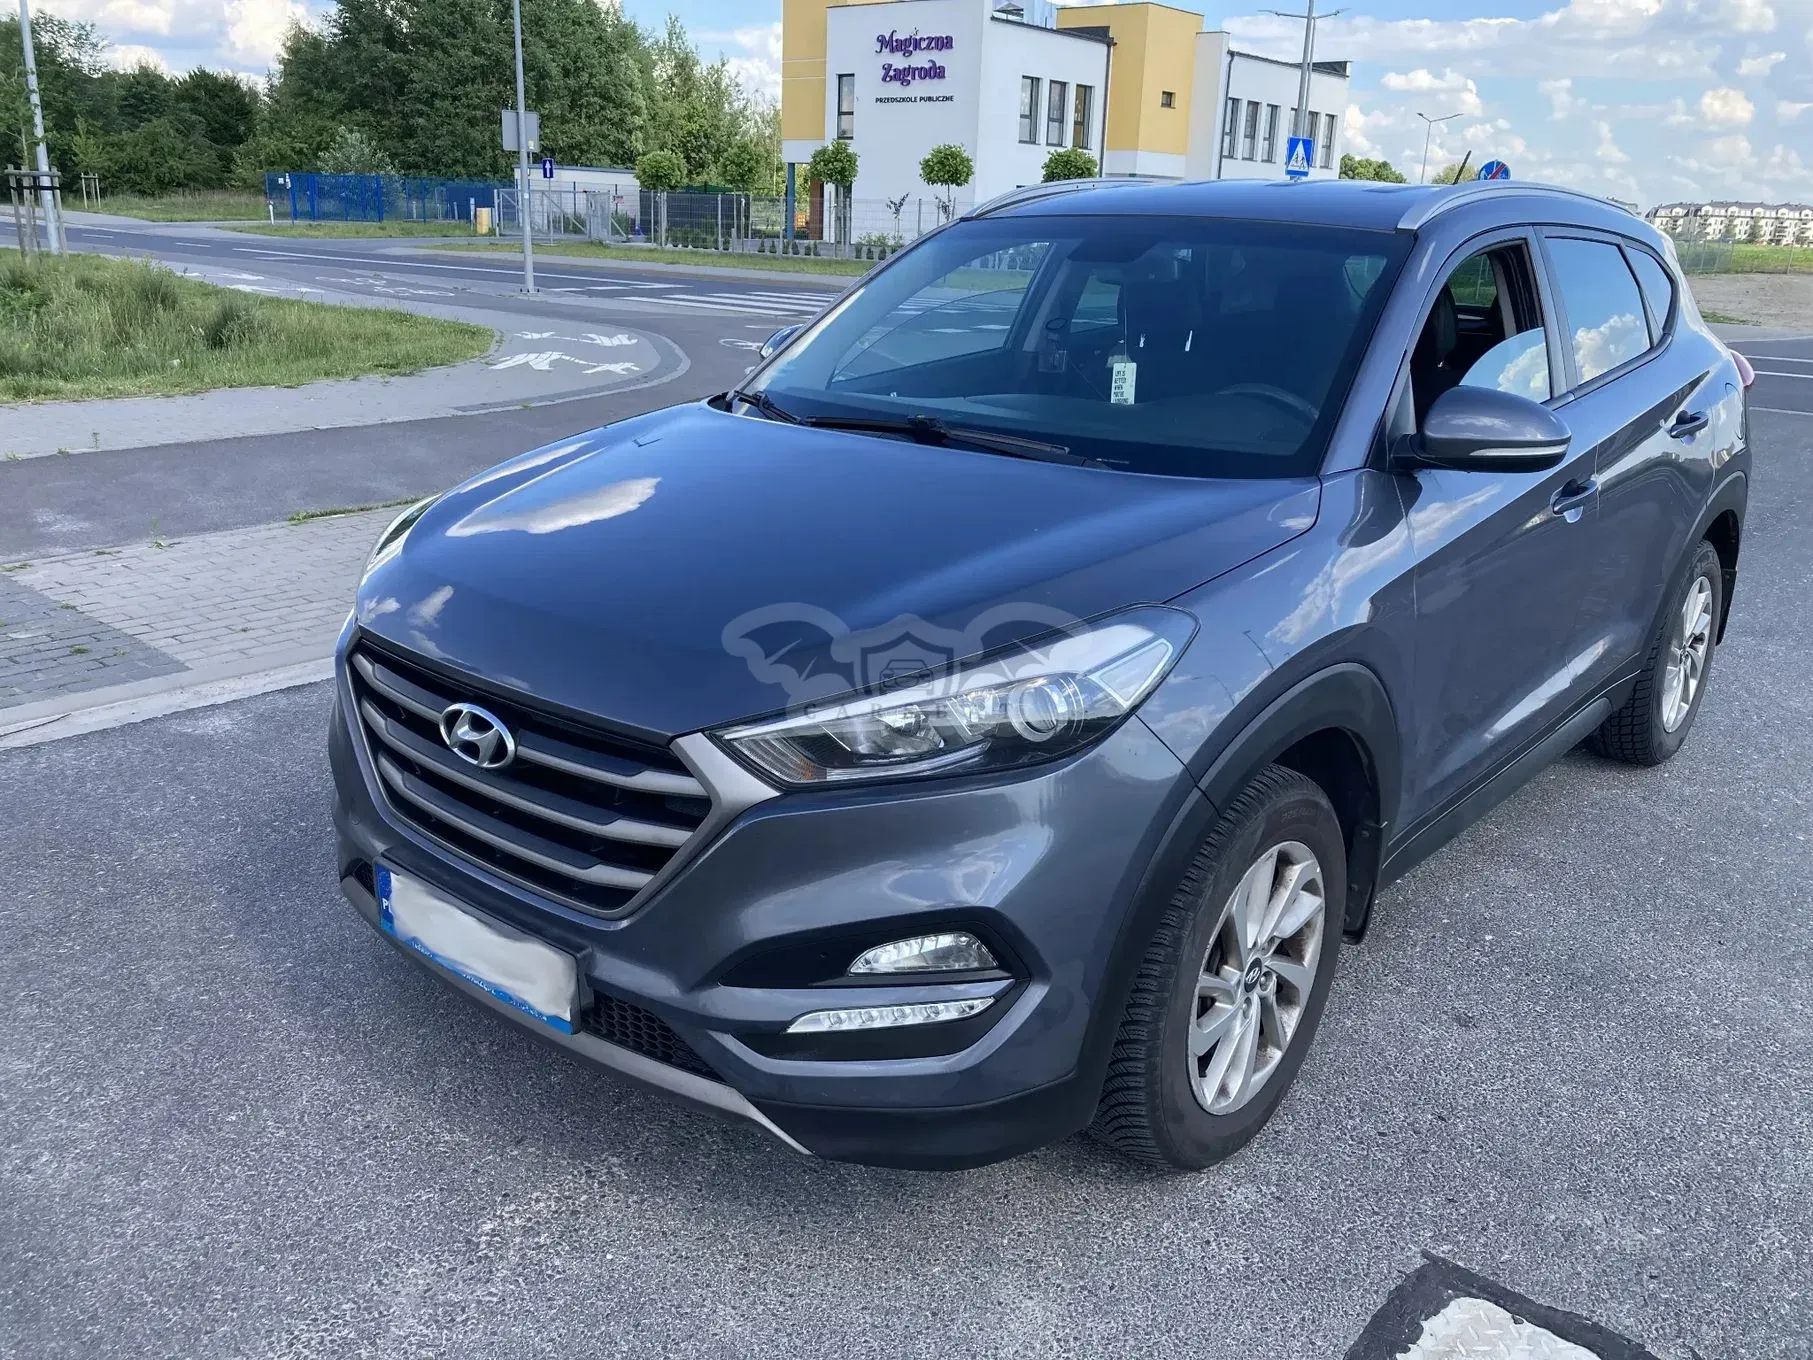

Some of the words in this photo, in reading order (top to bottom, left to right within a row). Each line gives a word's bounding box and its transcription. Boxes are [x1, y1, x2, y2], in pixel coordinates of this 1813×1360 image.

[875, 29, 954, 57] Magiczna
[881, 59, 946, 87] Zagroda
[919, 95, 955, 103] PUBLICZNE
